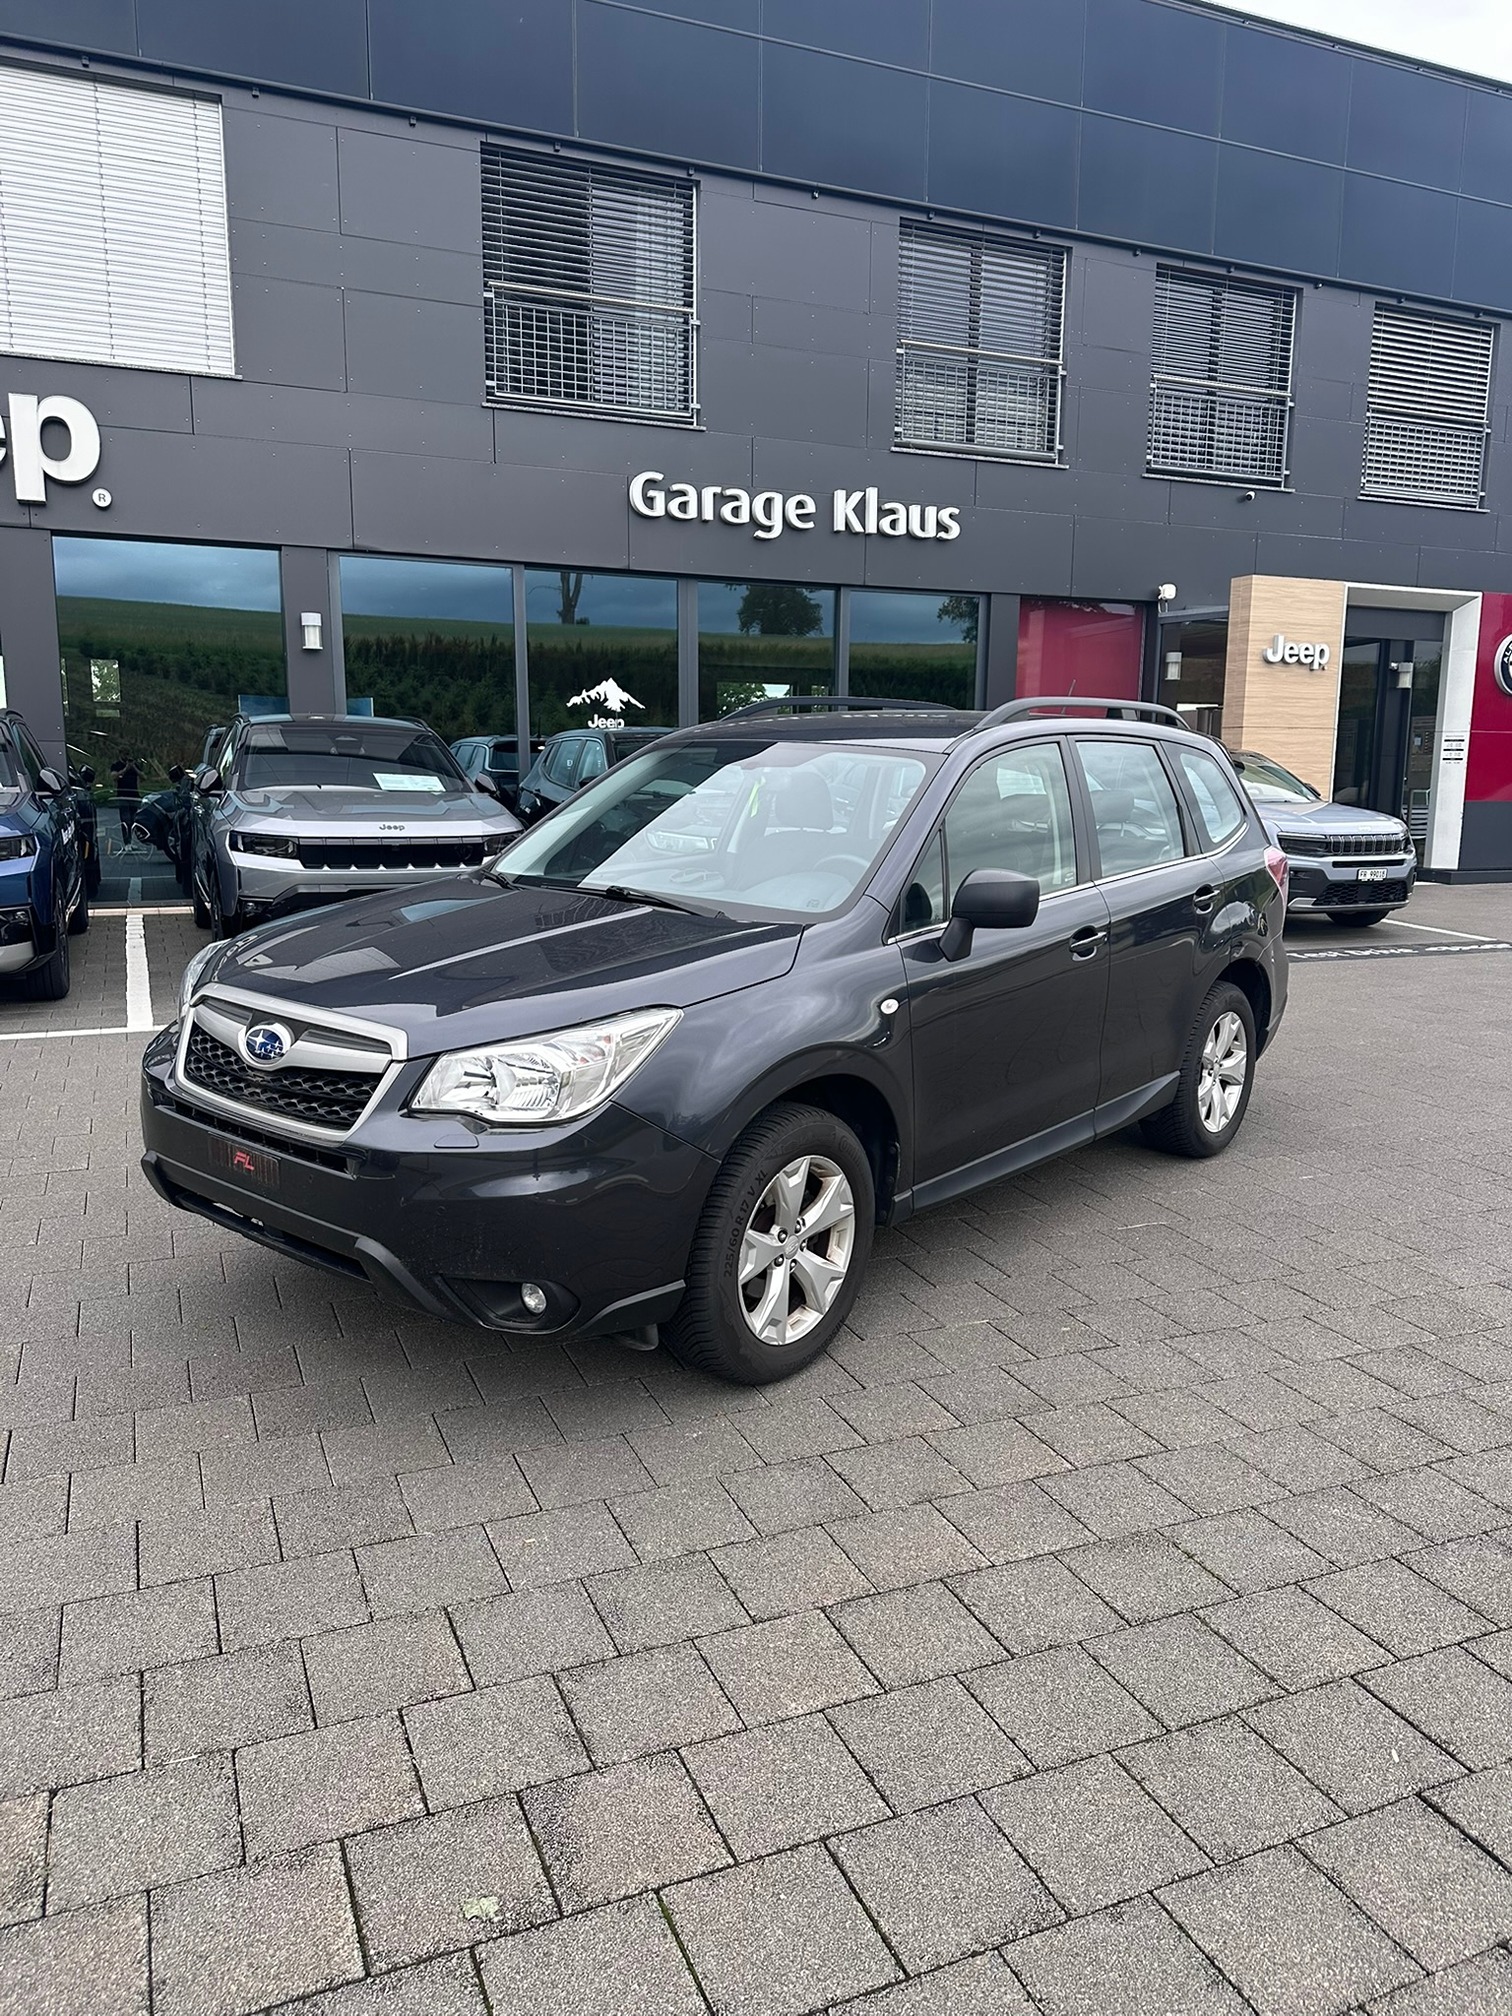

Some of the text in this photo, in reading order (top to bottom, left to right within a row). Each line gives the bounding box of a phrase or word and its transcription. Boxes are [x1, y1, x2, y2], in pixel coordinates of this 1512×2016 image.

[0, 392, 101, 505] p
[629, 471, 961, 540] Garage Klaus
[1263, 634, 1330, 671] Jeep
[588, 714, 625, 729] Jeep
[379, 823, 405, 831] Jeep
[233, 1151, 255, 1171] FL
[724, 1169, 769, 1277] 225/60 R 17 V XL
